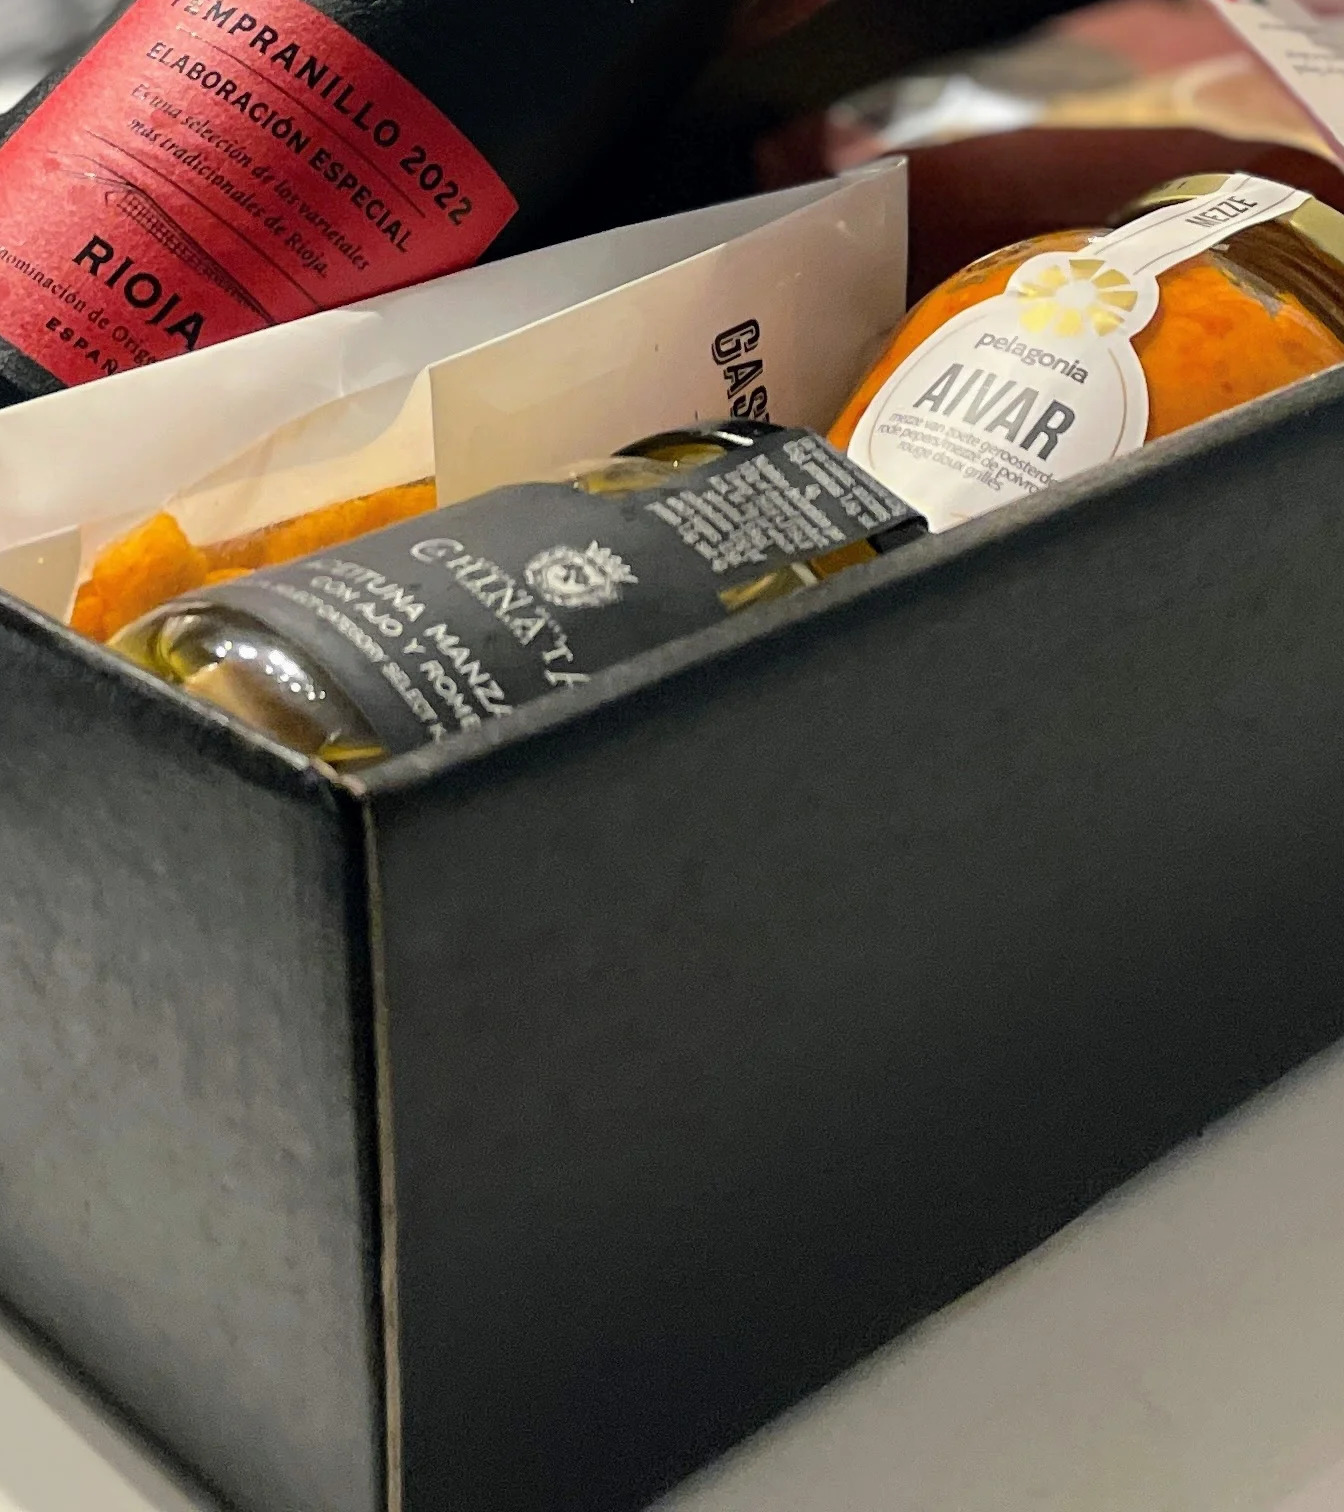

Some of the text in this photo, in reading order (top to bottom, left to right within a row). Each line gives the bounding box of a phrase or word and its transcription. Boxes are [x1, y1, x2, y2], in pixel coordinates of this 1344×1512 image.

[146, 41, 413, 253] ELABORACIÓN ESPECIAL
[149, 94, 183, 119] una
[181, 115, 254, 168] selección
[252, 166, 275, 185] de
[273, 178, 300, 206] los
[297, 201, 370, 271] varietales
[159, 137, 267, 219] tradicionales
[264, 214, 288, 235] de
[399, 145, 473, 226] 2022
[1185, 195, 1258, 228] MEZZE
[72, 234, 205, 352] RIOJA
[87, 307, 110, 330] de
[712, 318, 770, 425] GAS
[974, 332, 1089, 384] pelagonia
[912, 362, 1076, 462] AIVAR
[980, 456, 999, 471] de
[403, 637, 427, 655] Y
